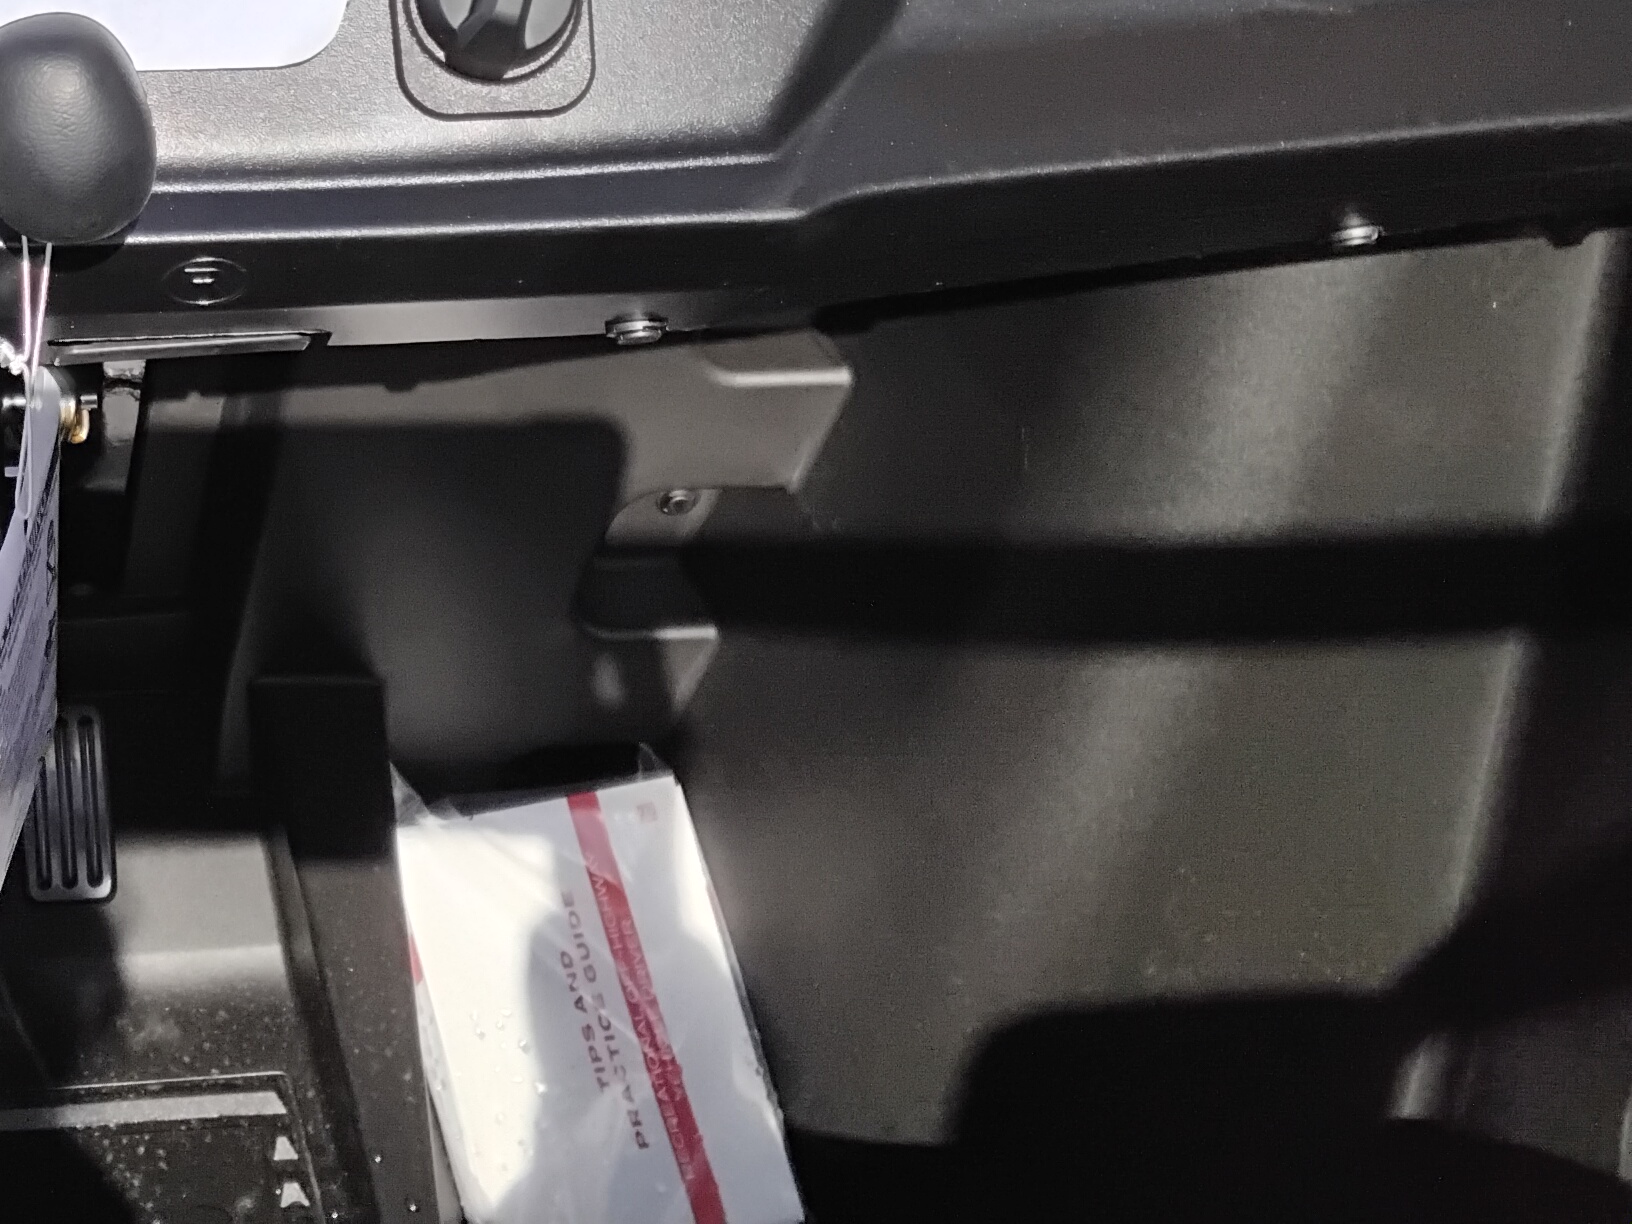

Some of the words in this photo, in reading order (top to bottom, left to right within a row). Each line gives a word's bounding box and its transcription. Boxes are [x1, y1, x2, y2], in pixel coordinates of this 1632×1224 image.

[562, 891, 596, 983] GUIDE
[560, 951, 588, 1014] AND
[582, 1024, 610, 1093] TIPS
[592, 992, 650, 1150] PRACTICE
